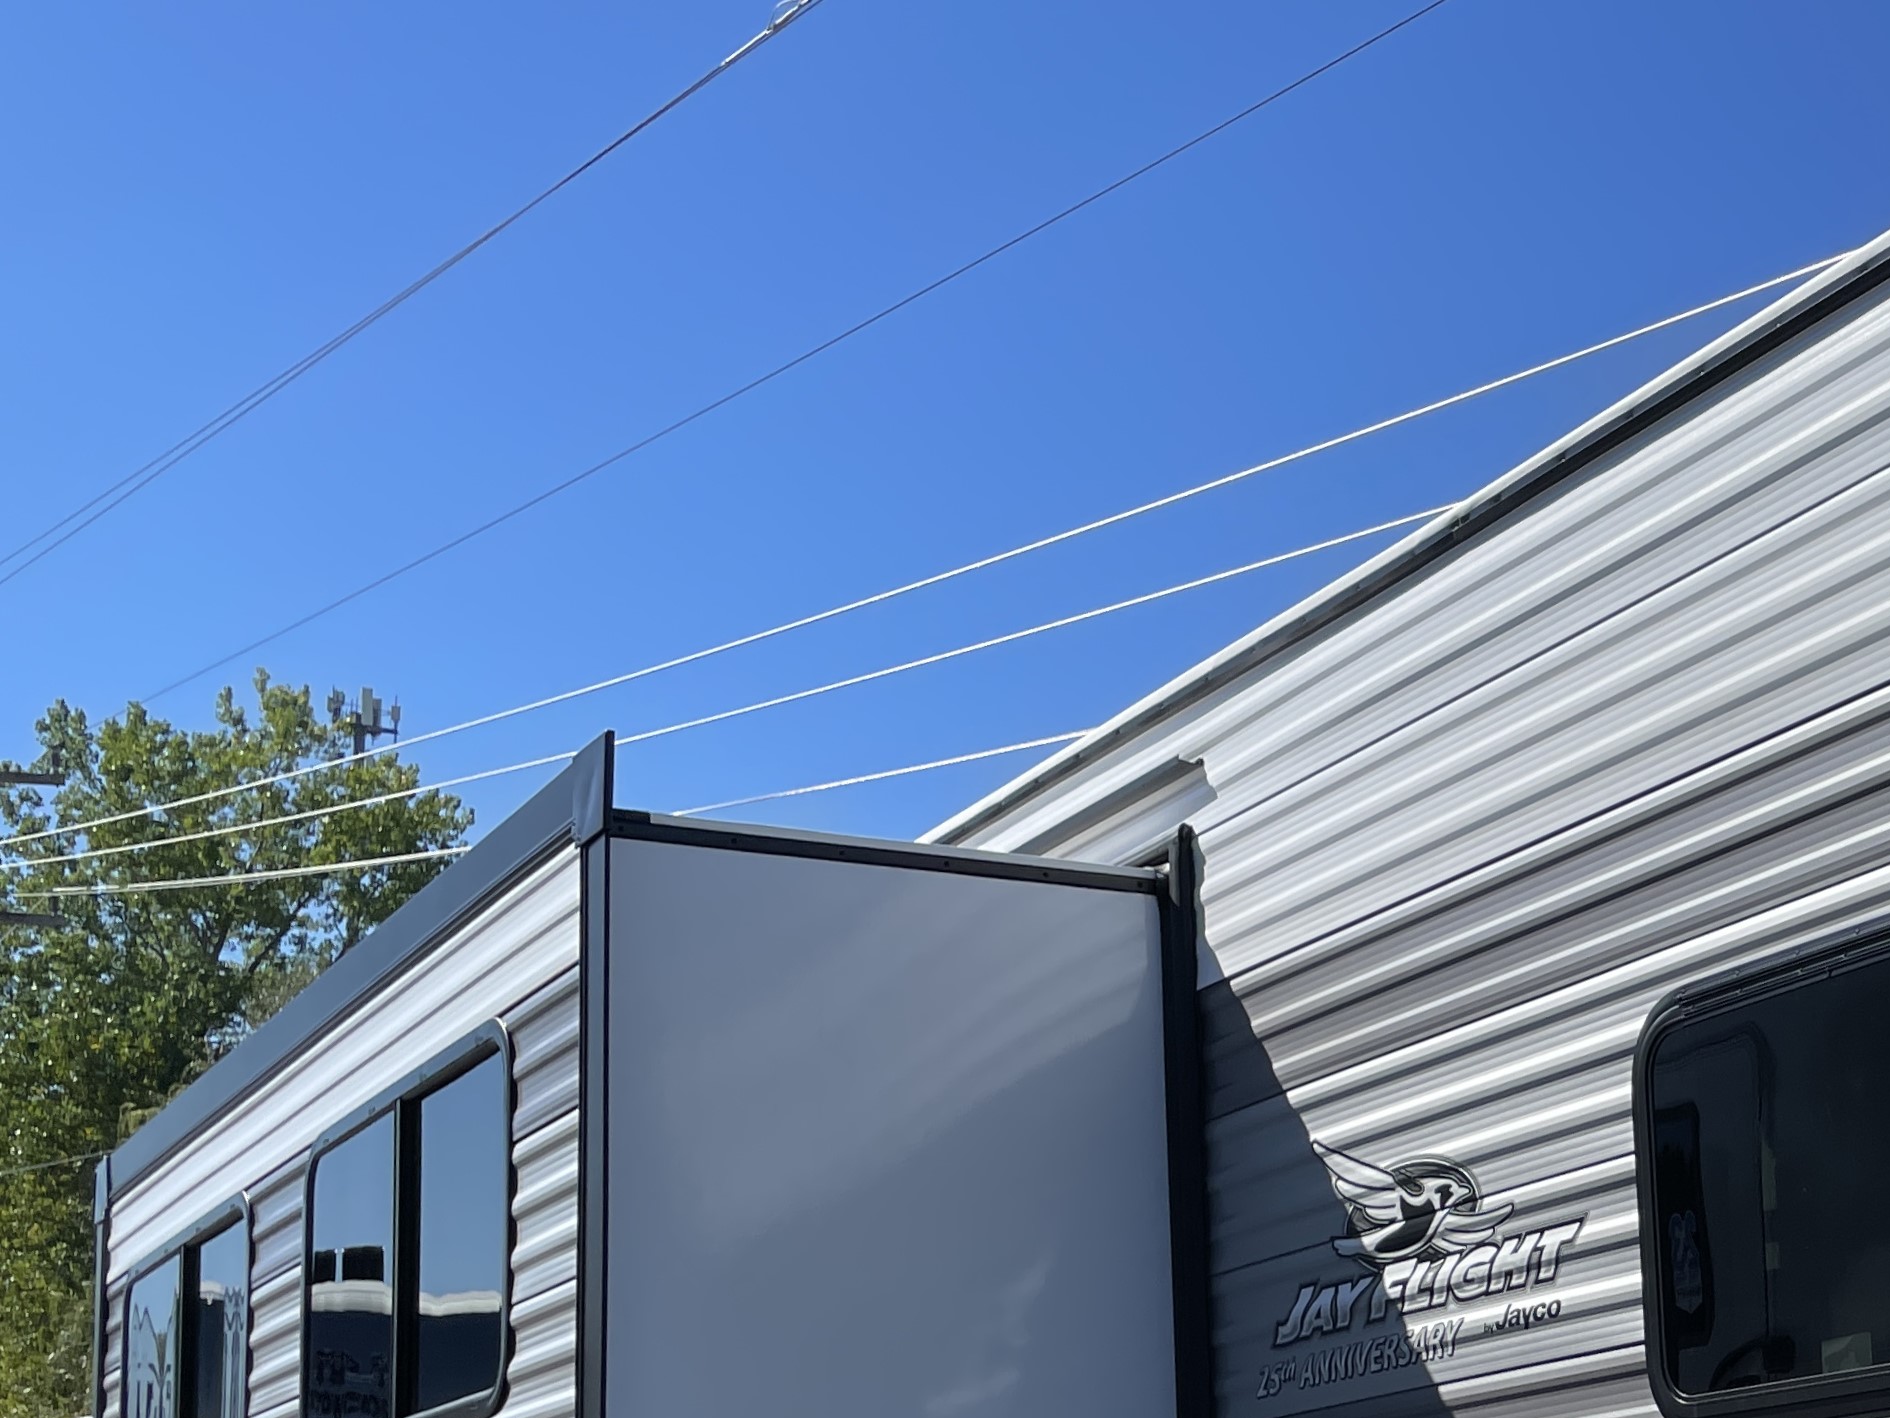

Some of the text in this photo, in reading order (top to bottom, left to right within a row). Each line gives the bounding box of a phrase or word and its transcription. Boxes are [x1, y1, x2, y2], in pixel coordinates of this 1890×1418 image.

[1273, 1213, 1588, 1348] JAY FLIGHT
[1495, 1299, 1562, 1331] Jayco
[1256, 1317, 1464, 1400] 25th ANNIVERSARY
